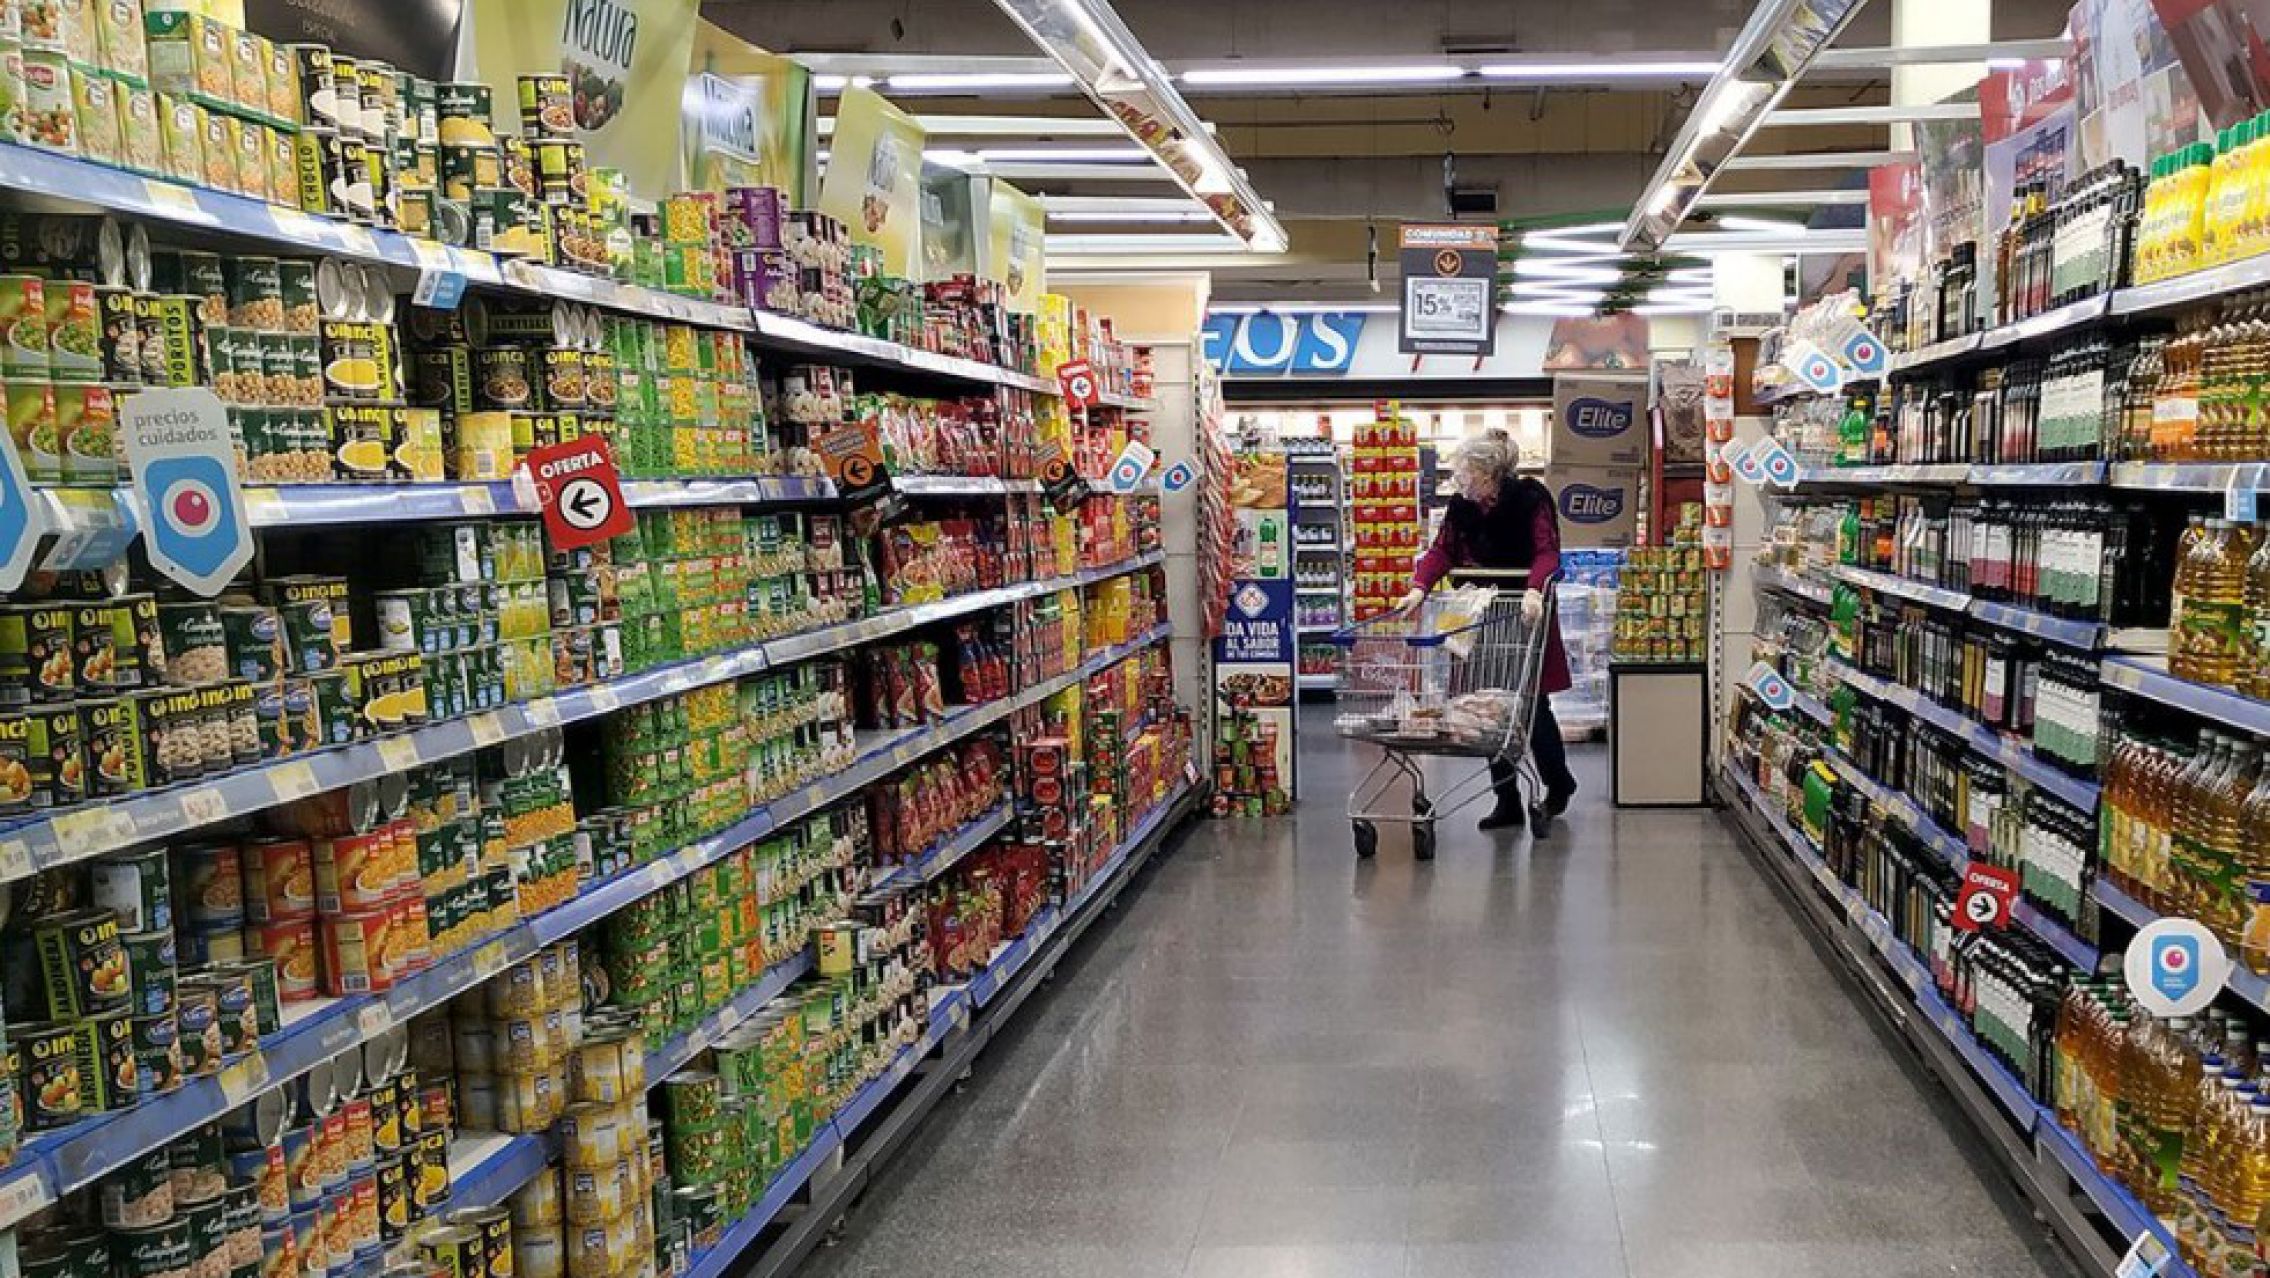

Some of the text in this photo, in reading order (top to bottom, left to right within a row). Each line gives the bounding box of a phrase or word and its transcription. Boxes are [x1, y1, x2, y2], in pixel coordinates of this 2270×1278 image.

[563, 0, 637, 69] Natura
[302, 145, 320, 203] CHOCLO
[165, 305, 187, 383] POROTOS
[134, 408, 199, 431] precios
[1578, 406, 1626, 430] Elite
[139, 427, 217, 447] cuidados
[541, 460, 604, 478] OFERTA
[1569, 491, 1617, 515] Elite
[1247, 621, 1279, 636] VIDA
